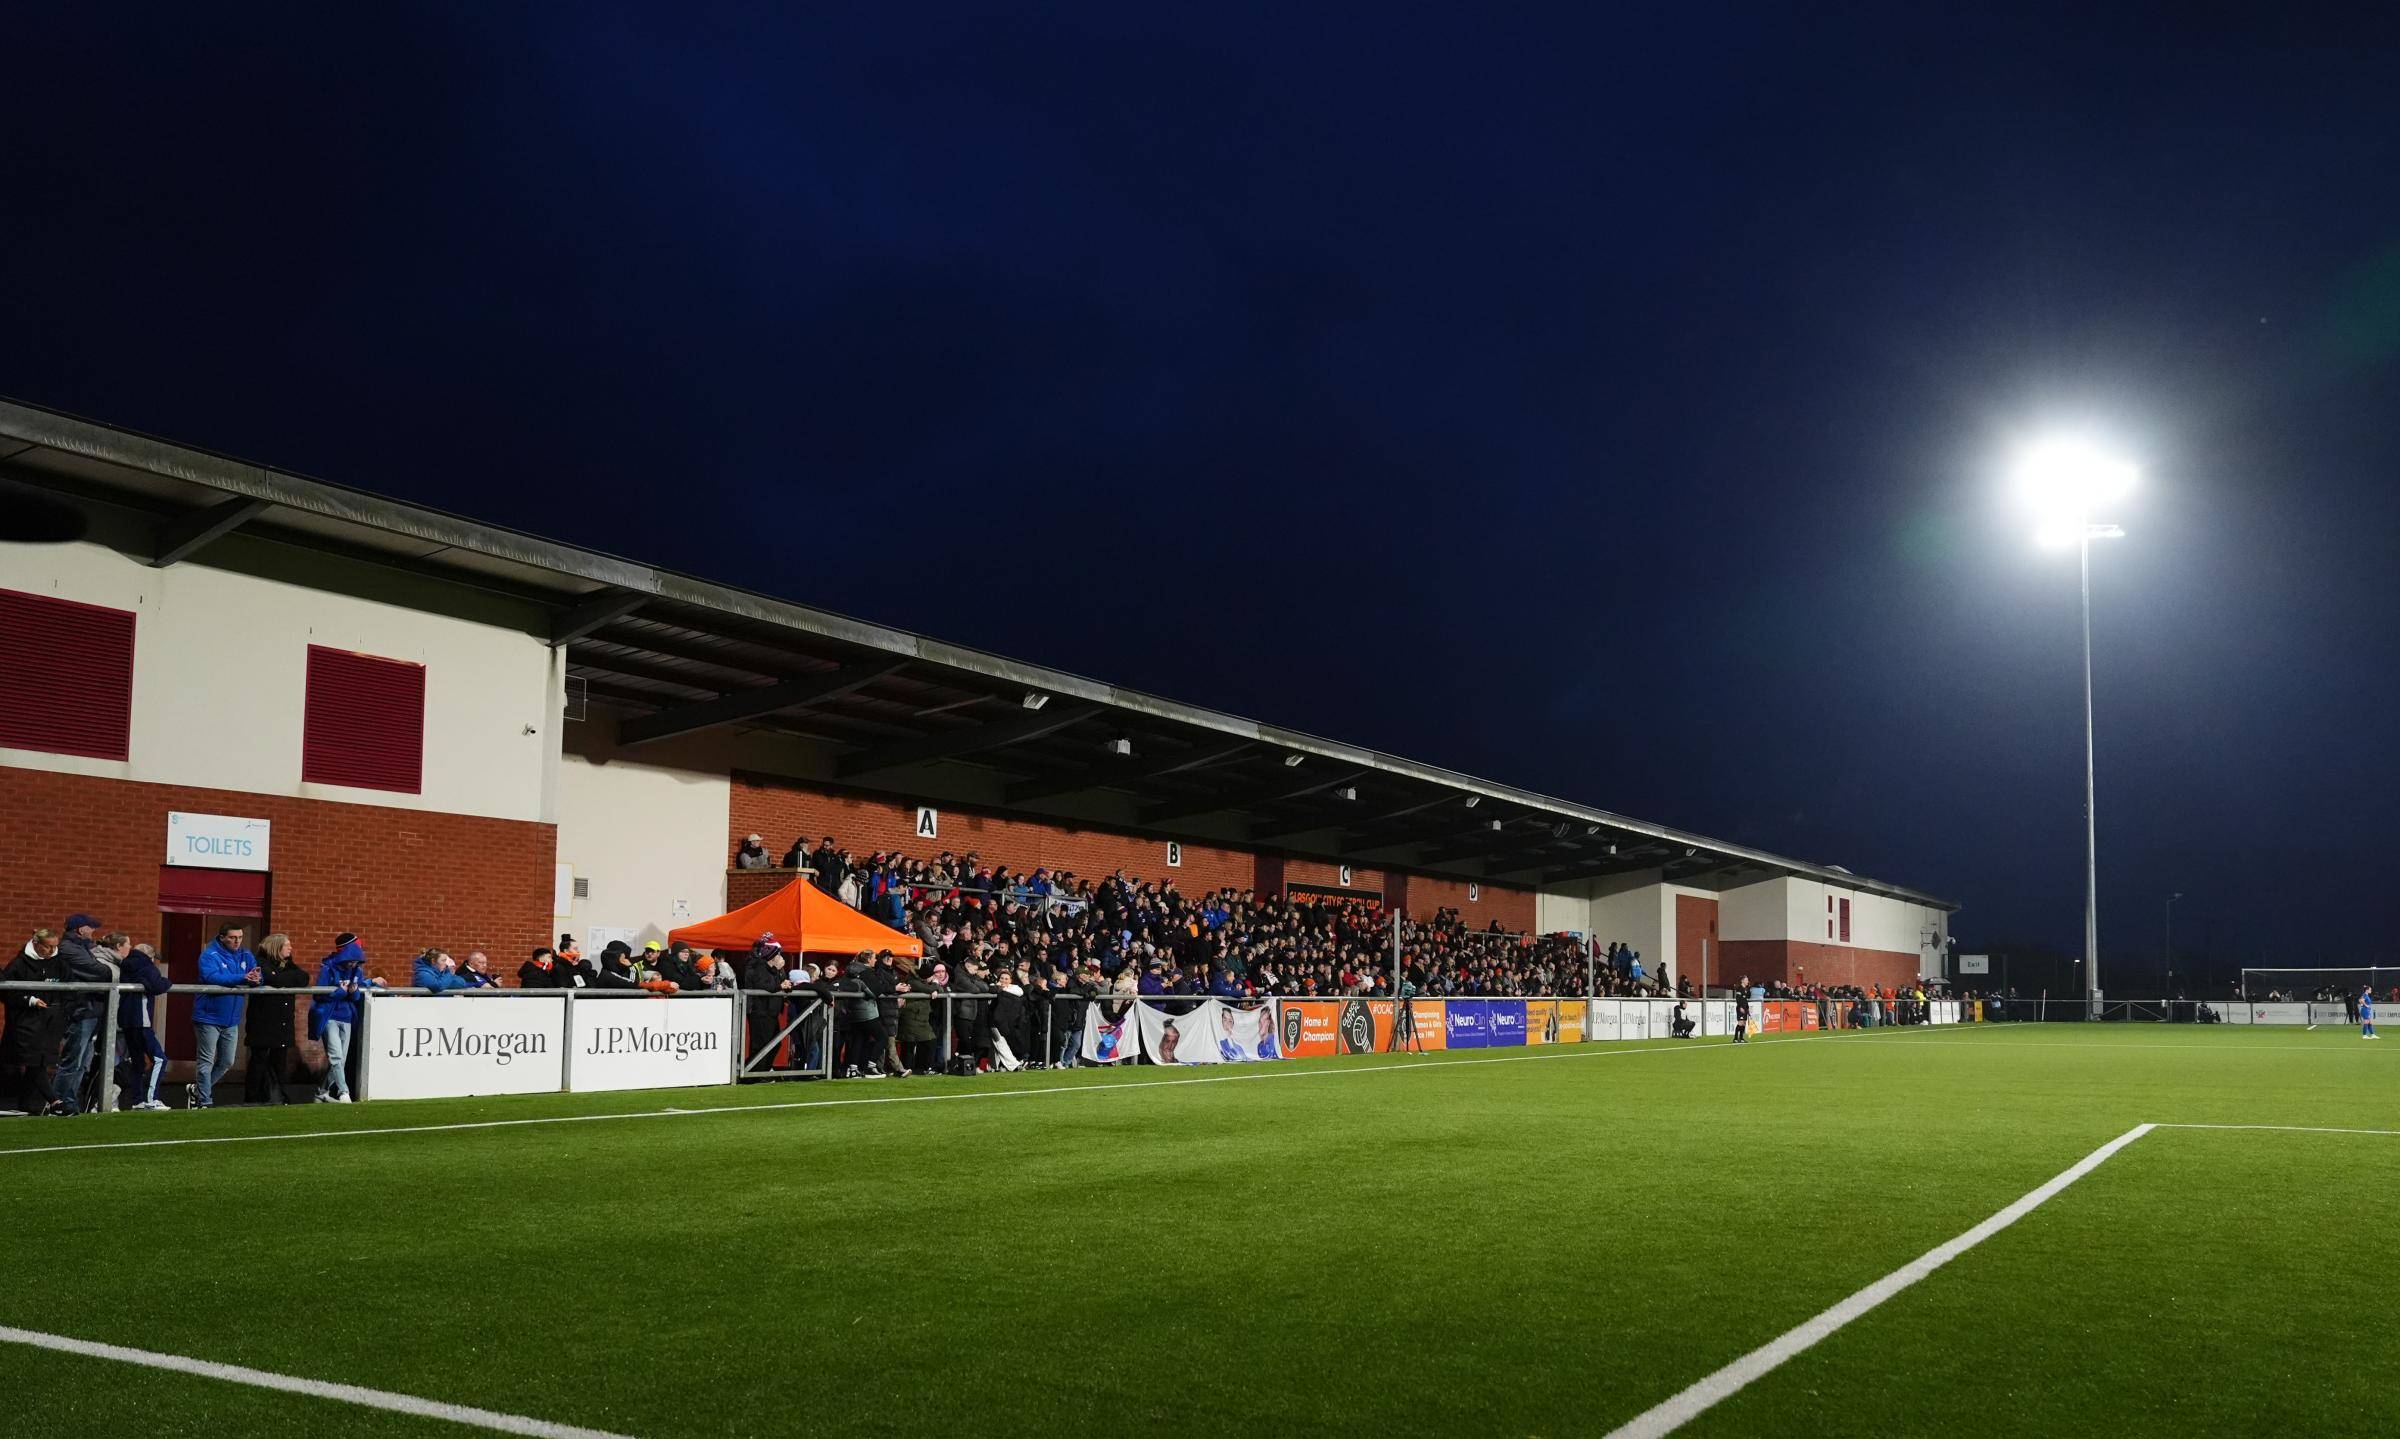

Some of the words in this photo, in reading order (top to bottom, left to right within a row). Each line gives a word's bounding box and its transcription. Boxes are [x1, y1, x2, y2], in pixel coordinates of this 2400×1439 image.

[919, 810, 935, 835] A
[185, 835, 253, 857] TOILETS
[1169, 843, 1179, 864] B
[1342, 865, 1350, 884] C
[1289, 890, 1322, 904] GLASGO
[1470, 883, 1477, 899] D
[1303, 1016, 1322, 1027] Home
[1322, 1016, 1329, 1027] of
[389, 1026, 547, 1066] J.P.Morgan
[586, 1026, 718, 1062] J.P.Morgan
[1303, 1031, 1335, 1044] Champions
